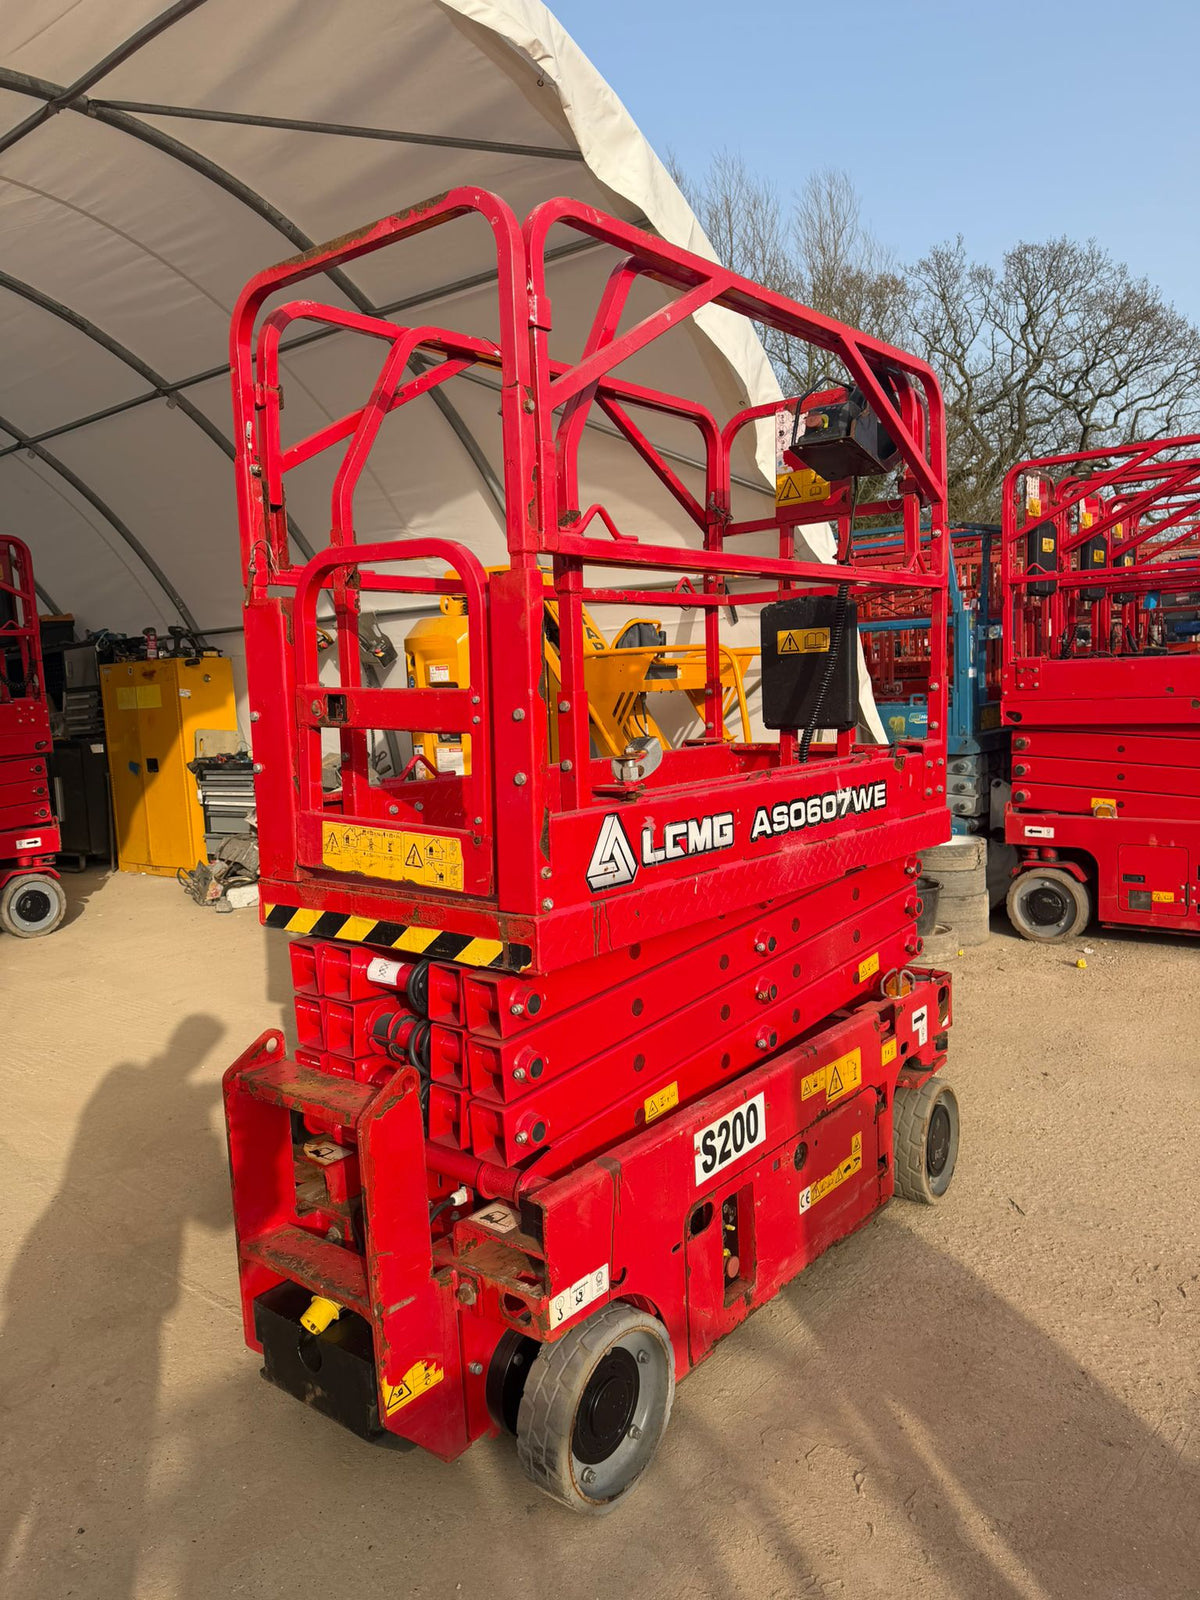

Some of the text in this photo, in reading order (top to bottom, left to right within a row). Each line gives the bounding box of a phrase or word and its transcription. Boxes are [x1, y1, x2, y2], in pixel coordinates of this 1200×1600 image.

[642, 781, 887, 867] LGMG AS0607WE
[702, 1102, 759, 1174] S200
